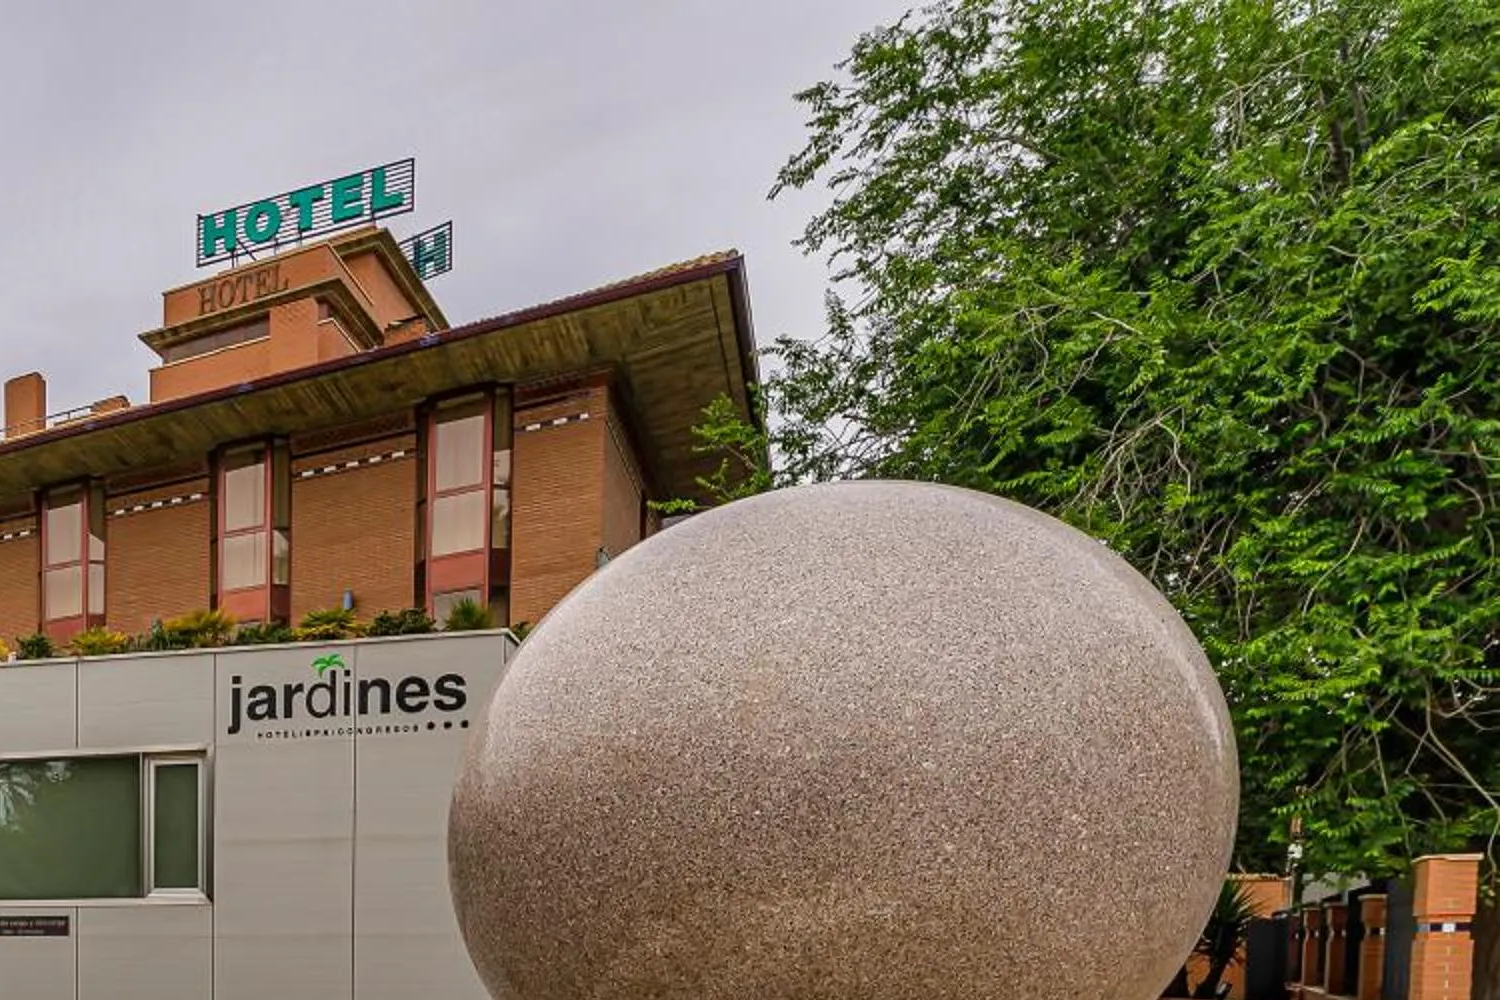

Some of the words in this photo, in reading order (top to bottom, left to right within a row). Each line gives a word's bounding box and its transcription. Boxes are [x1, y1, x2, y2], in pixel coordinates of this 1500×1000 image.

[202, 167, 405, 257] HOTEL
[198, 264, 288, 313] HOTEL
[228, 669, 467, 734] jardines
